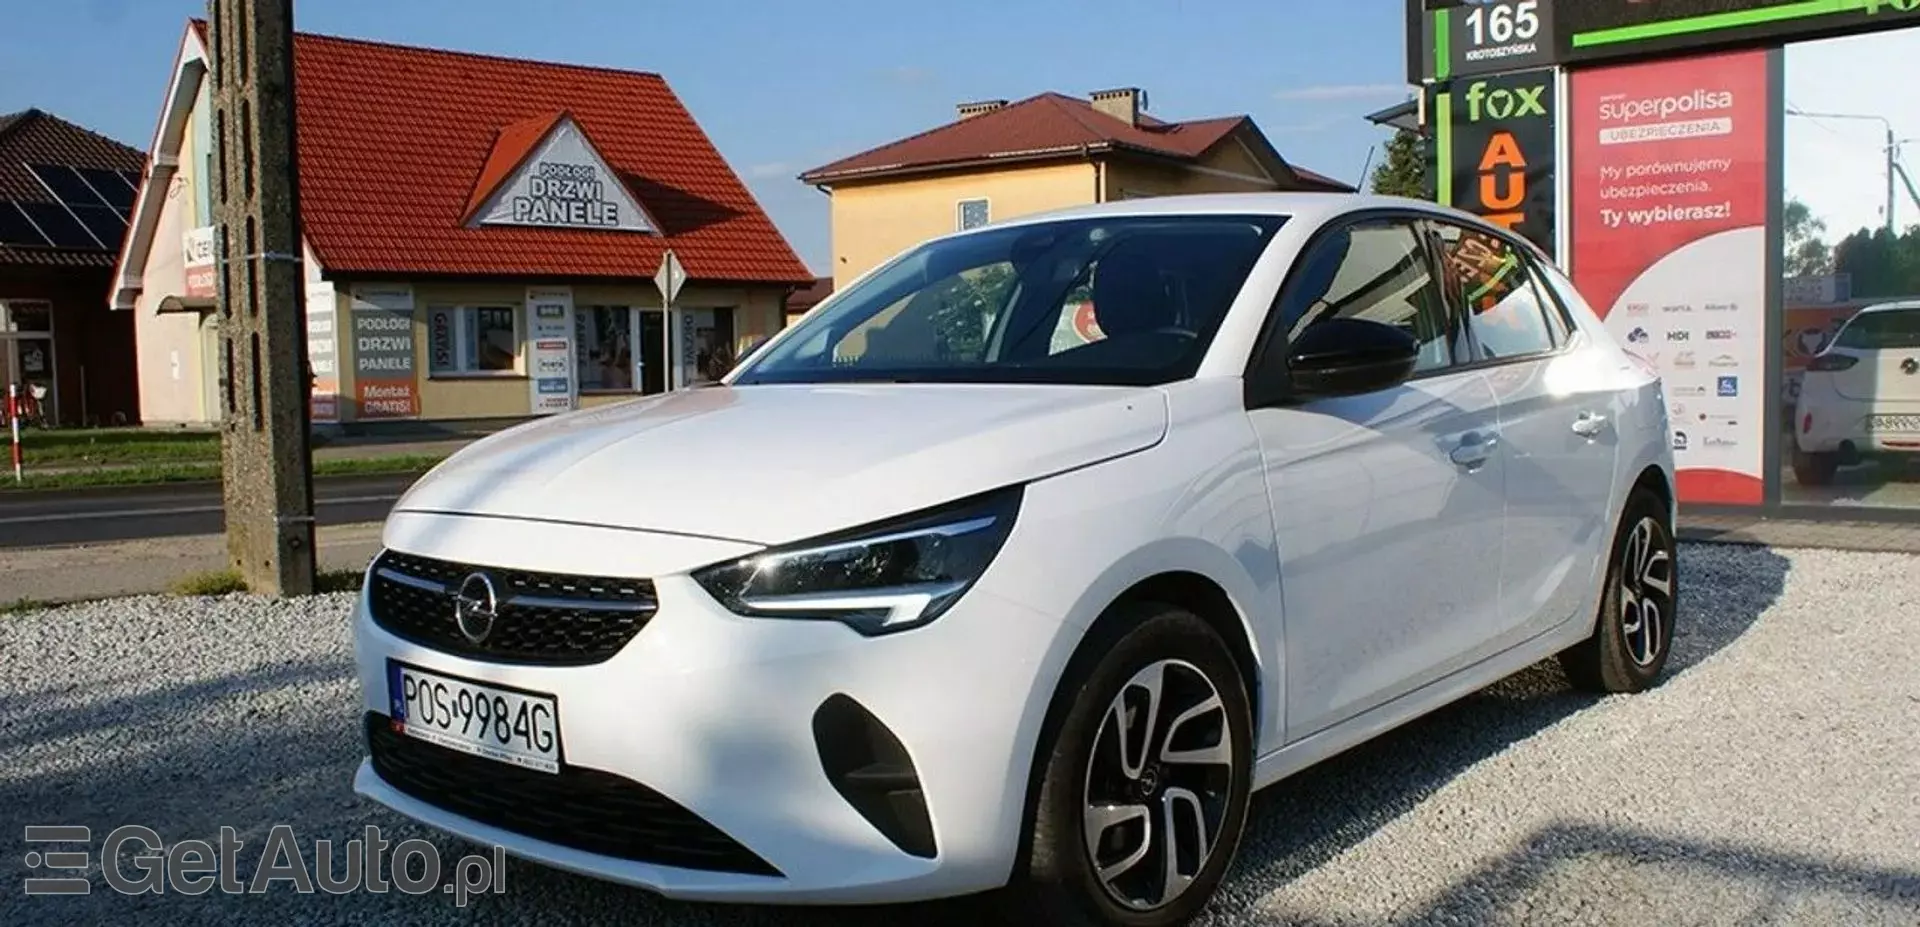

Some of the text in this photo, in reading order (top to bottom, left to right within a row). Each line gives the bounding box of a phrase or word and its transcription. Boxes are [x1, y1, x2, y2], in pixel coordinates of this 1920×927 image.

[1465, 1, 1539, 45] 165
[1465, 43, 1537, 60] KROTOSZYŃSKA
[1465, 81, 1546, 121] fox
[1599, 89, 1733, 122] superpolisa
[1610, 121, 1721, 141] UBEZPIECZENIA
[540, 162, 595, 179] PODŁOGI
[1601, 158, 1732, 181] My porównujemy
[531, 177, 602, 199] DRZWI
[1601, 180, 1712, 199] ubezpieczenia.
[515, 198, 618, 225] PANELE
[1601, 200, 1731, 228] Ty wybierasz!
[357, 318, 411, 330] PODŁOGI
[358, 337, 411, 351] DRZWI
[359, 357, 411, 371] PANELE
[404, 674, 451, 729] POS
[458, 689, 553, 753] 9984G
